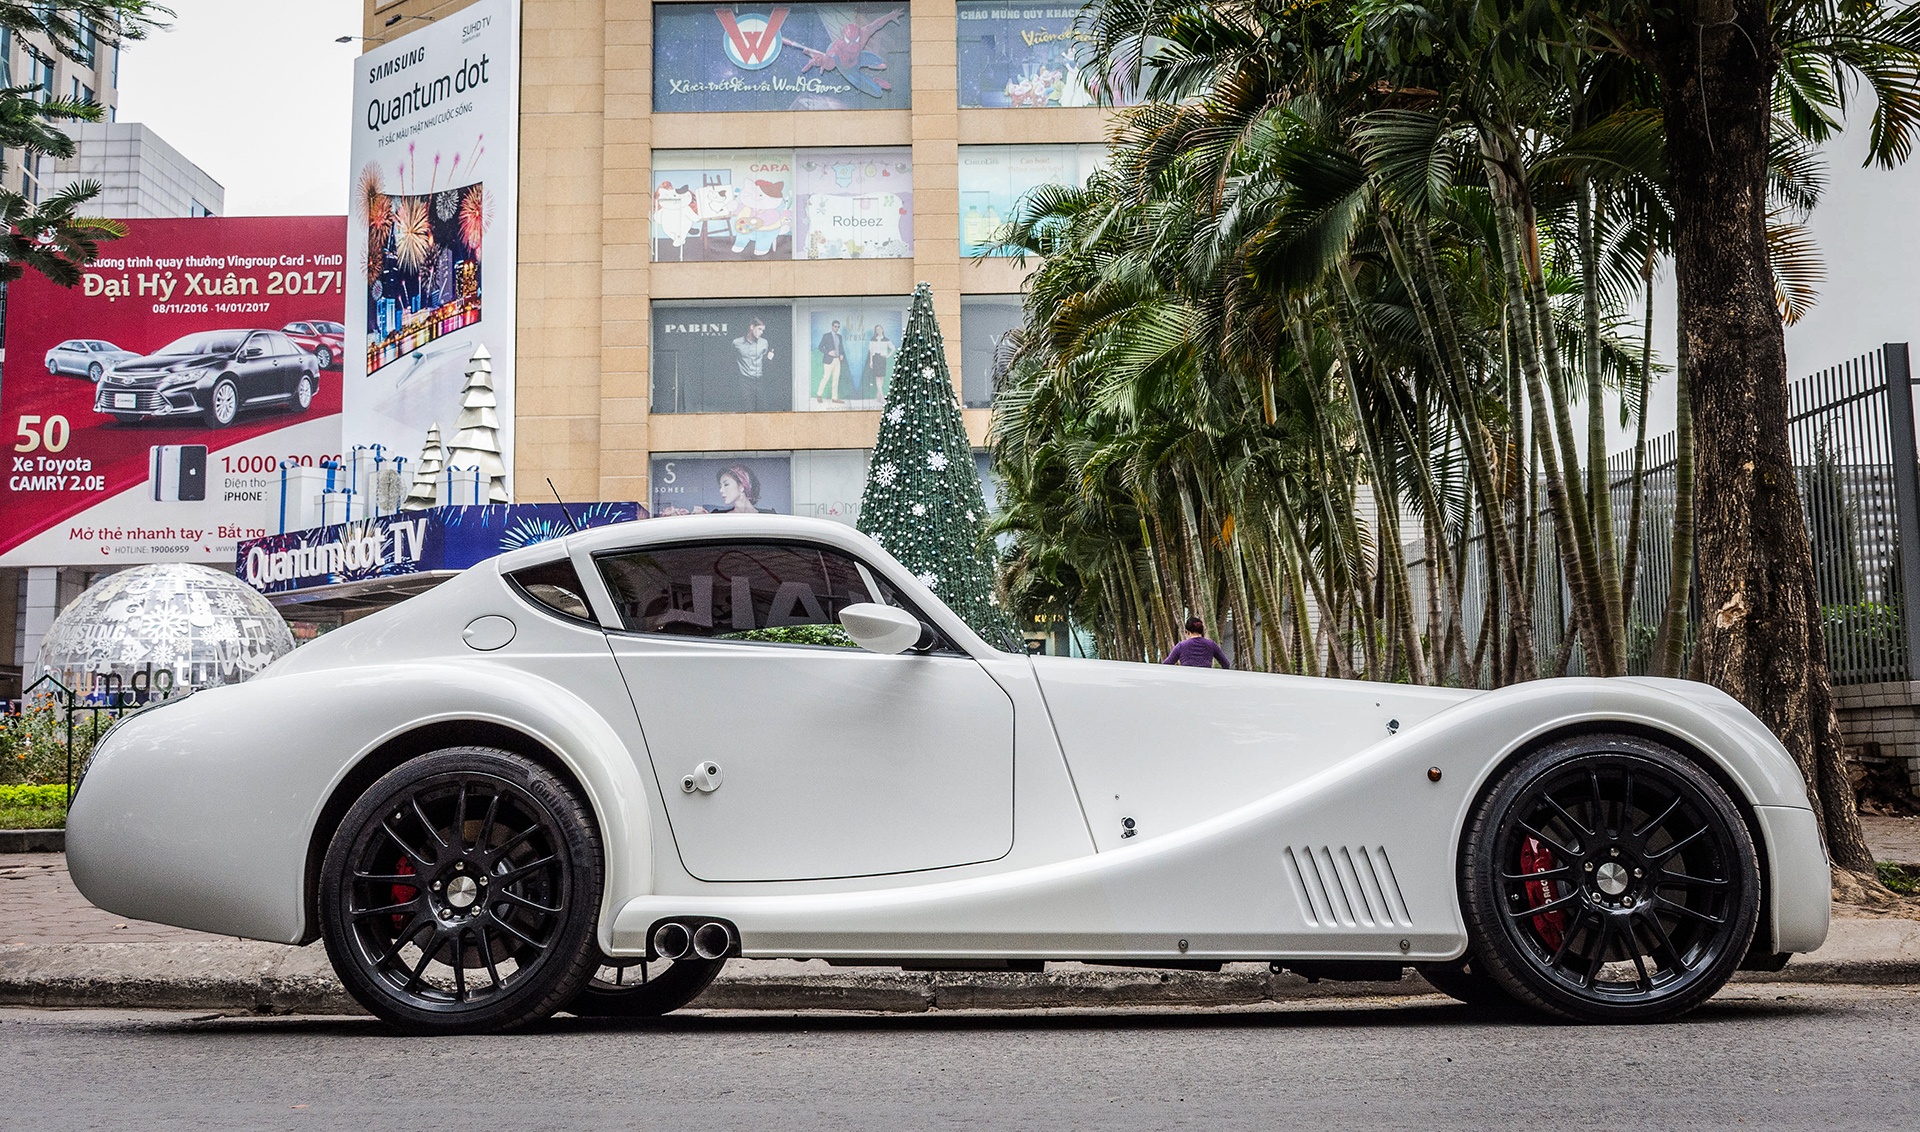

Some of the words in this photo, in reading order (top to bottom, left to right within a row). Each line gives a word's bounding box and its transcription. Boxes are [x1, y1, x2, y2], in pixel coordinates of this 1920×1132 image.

[961, 8, 988, 20] CHÀO
[991, 7, 1020, 19] MỪNG
[1023, 7, 1042, 19] QUÝ
[462, 20, 482, 38] SUHD
[482, 14, 492, 28] TV
[369, 46, 425, 84] SAMSUNG
[367, 75, 451, 132] Quantum
[455, 54, 490, 94] dot
[806, 78, 851, 94] Games
[749, 163, 790, 173] CARA
[832, 215, 884, 227] Robeez
[127, 257, 153, 268] trình
[156, 258, 184, 270] quay
[185, 255, 225, 270] thưởng
[227, 255, 278, 269] Vingroup
[279, 254, 304, 266] Card
[313, 254, 343, 266] VinID
[83, 273, 131, 302] Đại
[137, 271, 178, 302] Hỷ
[184, 272, 259, 297] Xuân
[266, 271, 343, 295] 2017!
[152, 303, 209, 314] 08/11/2016
[214, 302, 271, 313] 14/01/2017
[665, 323, 729, 333] PABINI
[14, 414, 71, 453] 50
[12, 456, 34, 472] Xe
[36, 456, 92, 475] Toyota
[221, 455, 277, 474] 1.000
[9, 475, 68, 492] CAMRY
[69, 475, 106, 492] 2.0E
[224, 477, 248, 489] Điện
[654, 486, 685, 494] SOHEE
[224, 491, 262, 502] iPHONE
[69, 526, 95, 541] Mở
[98, 527, 123, 541] thẻ
[126, 527, 177, 540] nhanh
[180, 528, 204, 542] tay
[217, 523, 243, 539] Bắt
[115, 546, 149, 554] HOTLINE:
[150, 545, 190, 554] 19006959
[246, 540, 345, 590] Quantum
[346, 527, 387, 571] dot
[388, 517, 428, 564] TV
